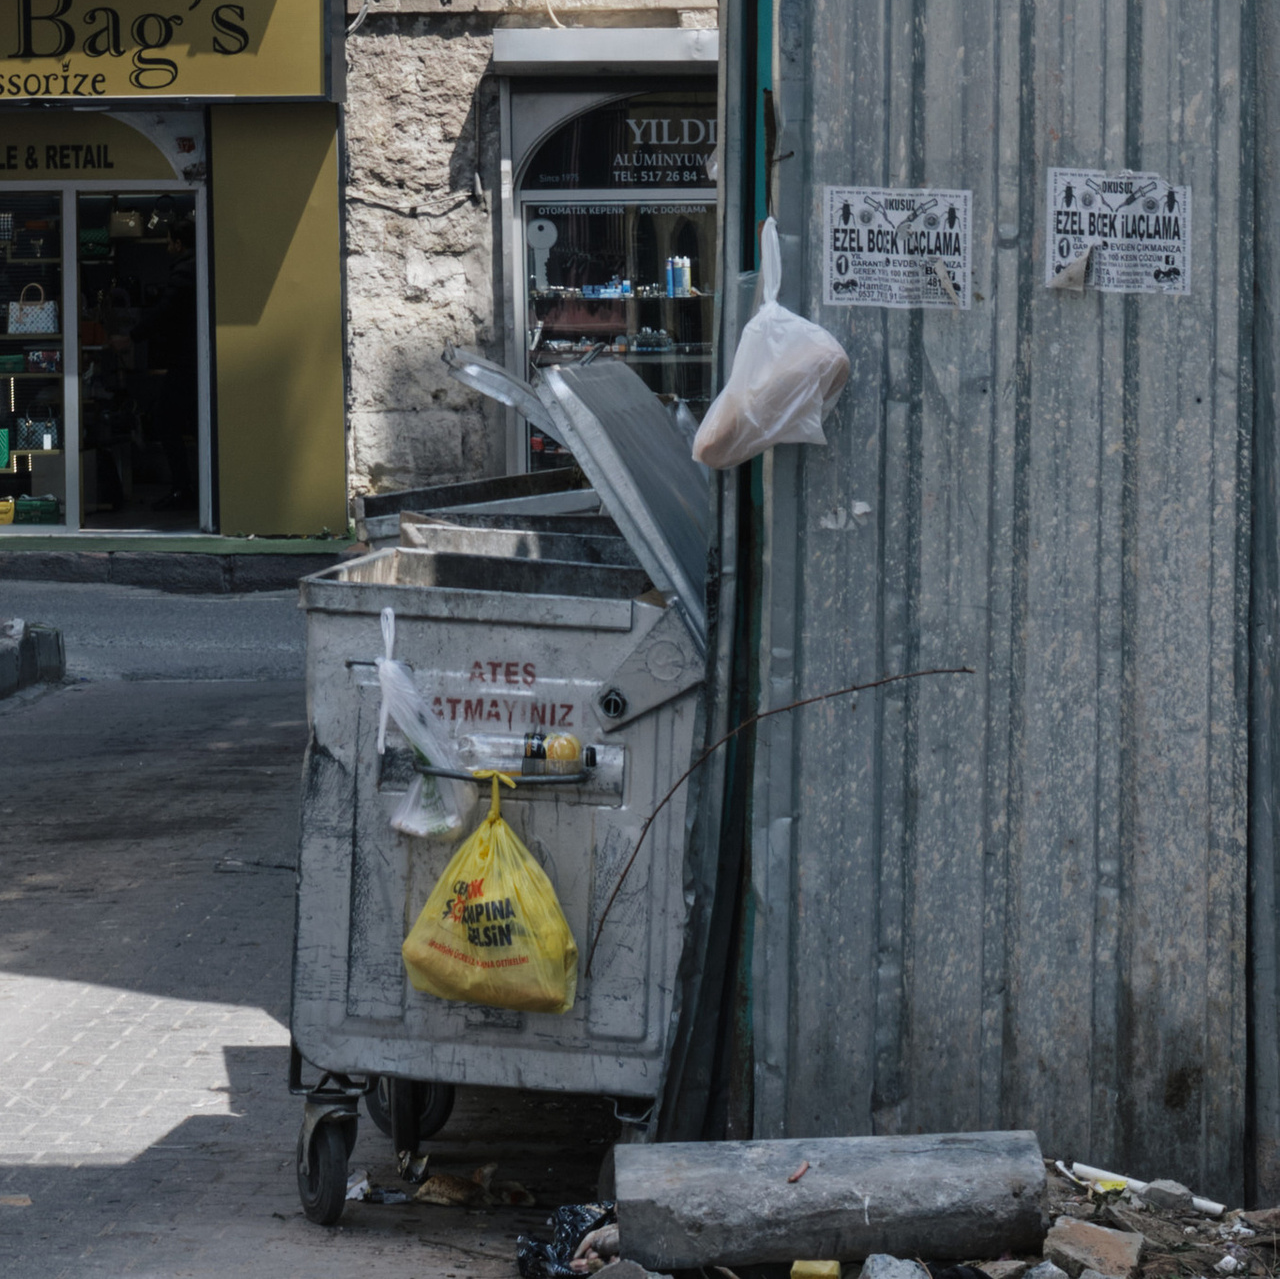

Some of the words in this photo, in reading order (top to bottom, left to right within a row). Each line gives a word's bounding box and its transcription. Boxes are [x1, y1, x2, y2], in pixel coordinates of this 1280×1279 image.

[24, 145, 39, 170] &
[44, 144, 114, 171] RETAIL
[613, 170, 638, 182] TEL:
[640, 170, 662, 182] 517
[665, 170, 680, 182] 26
[682, 170, 698, 182] 84
[588, 206, 625, 216] KEPENK
[640, 206, 658, 215] PVC
[1056, 210, 1085, 235] EZEL
[833, 228, 864, 253] EZEL
